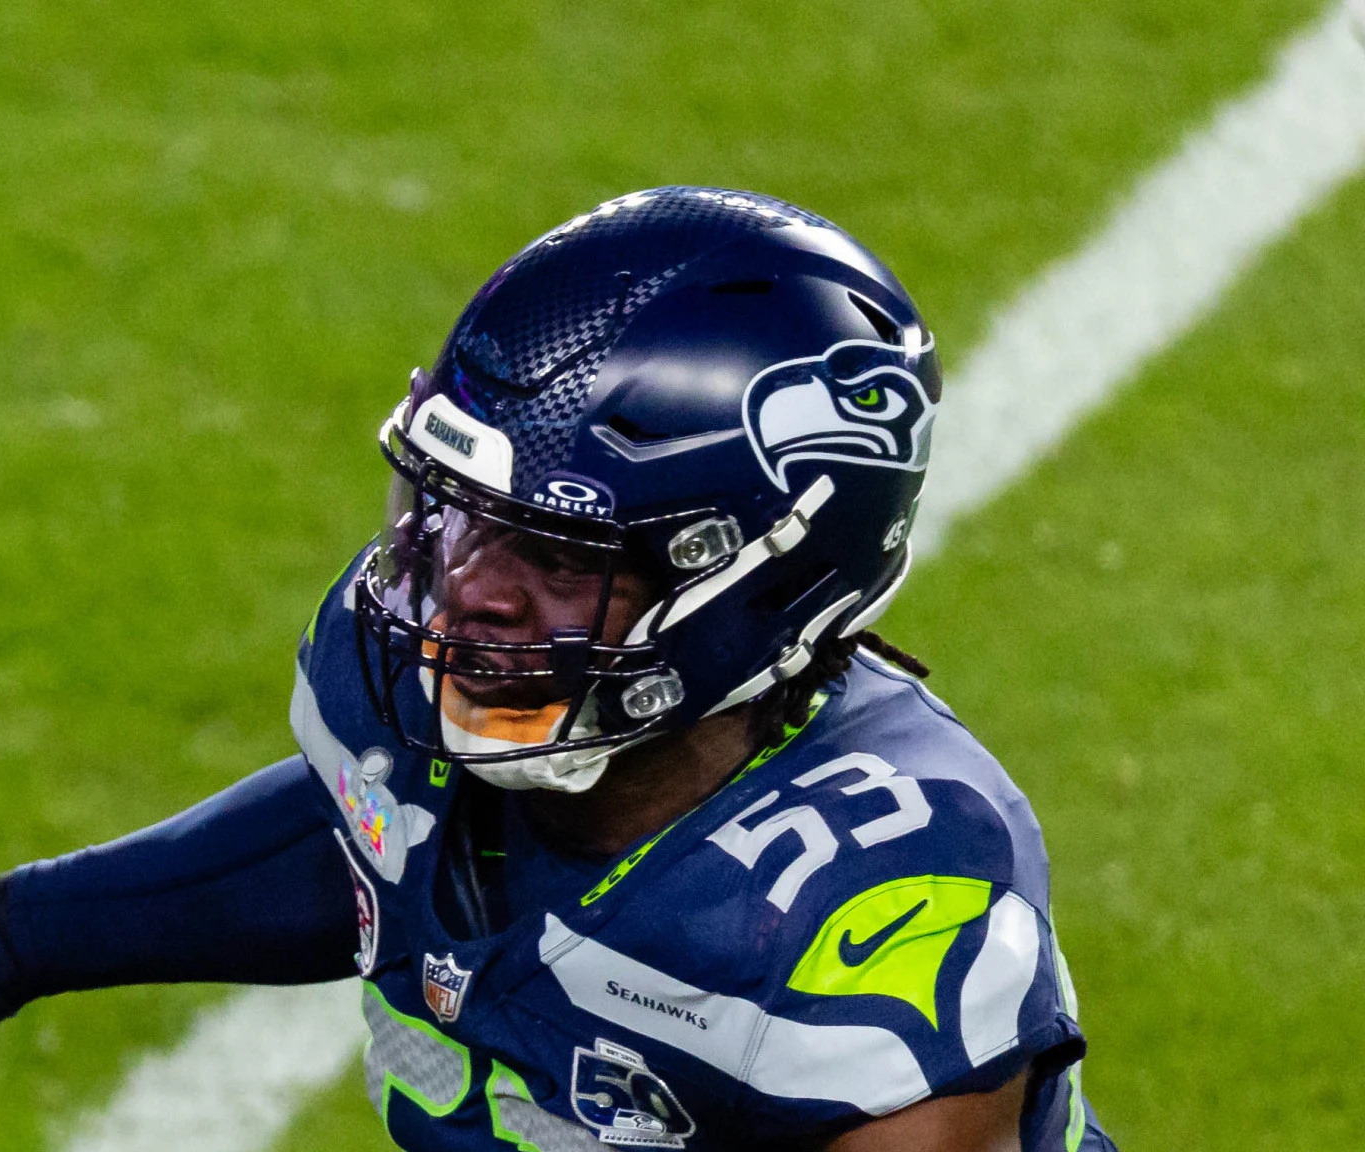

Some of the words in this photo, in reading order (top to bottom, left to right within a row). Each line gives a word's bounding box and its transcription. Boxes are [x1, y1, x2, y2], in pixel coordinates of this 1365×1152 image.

[424, 412, 475, 457] SEAHAWKS
[533, 492, 609, 516] OAKLEY
[705, 751, 933, 914] 53
